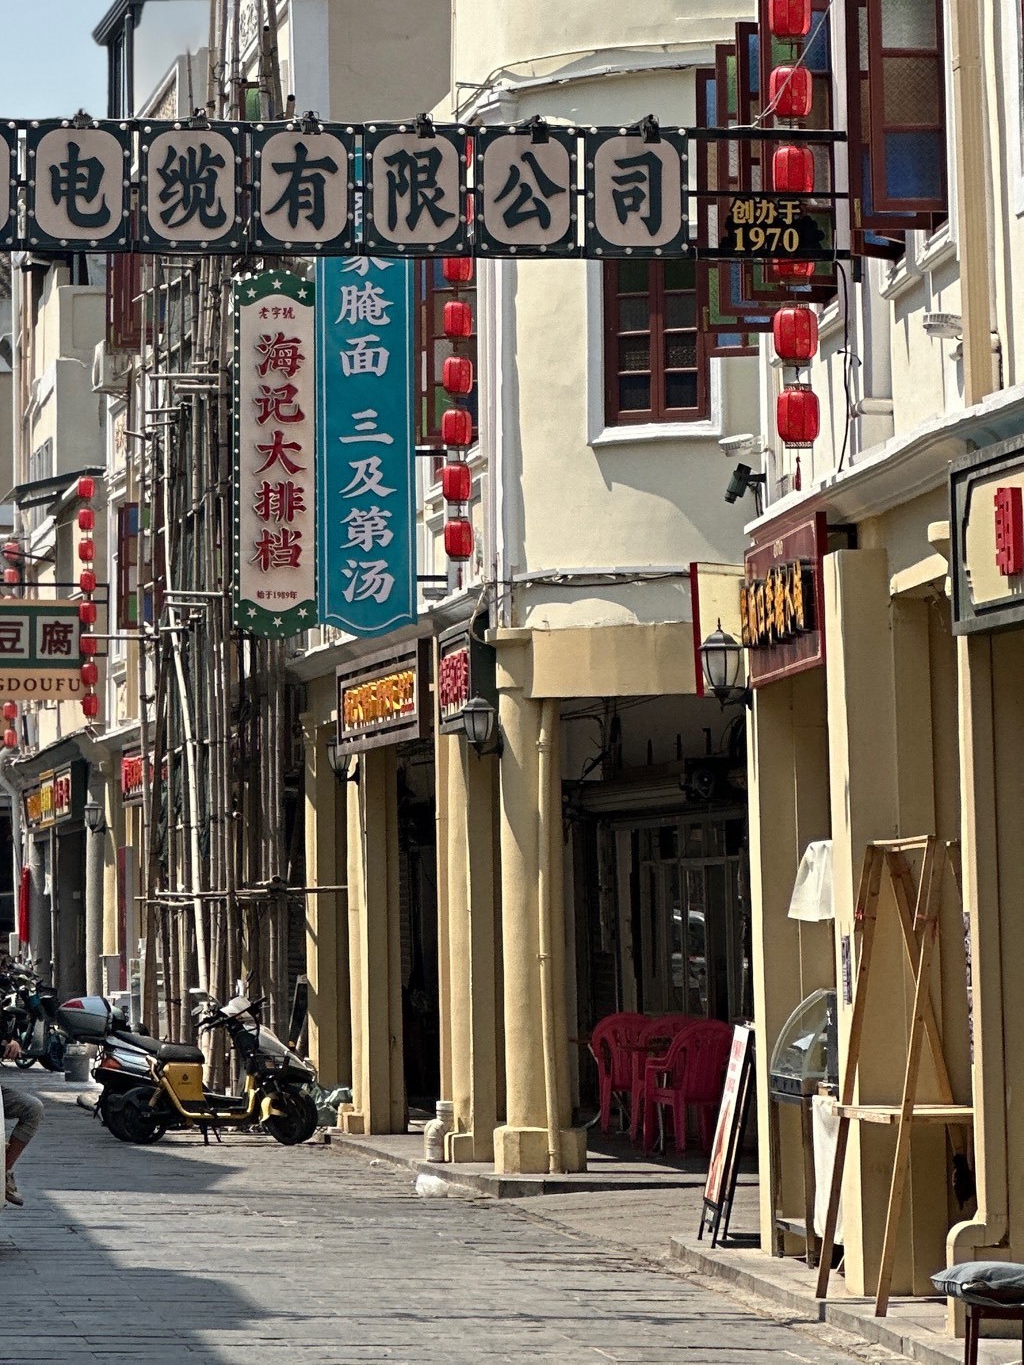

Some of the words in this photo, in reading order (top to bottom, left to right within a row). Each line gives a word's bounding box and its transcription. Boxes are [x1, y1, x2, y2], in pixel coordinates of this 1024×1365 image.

[732, 200, 801, 225] 创办于
[734, 227, 800, 253] 1970
[251, 332, 307, 574] 海记大排档
[339, 409, 397, 604] 三及第汤
